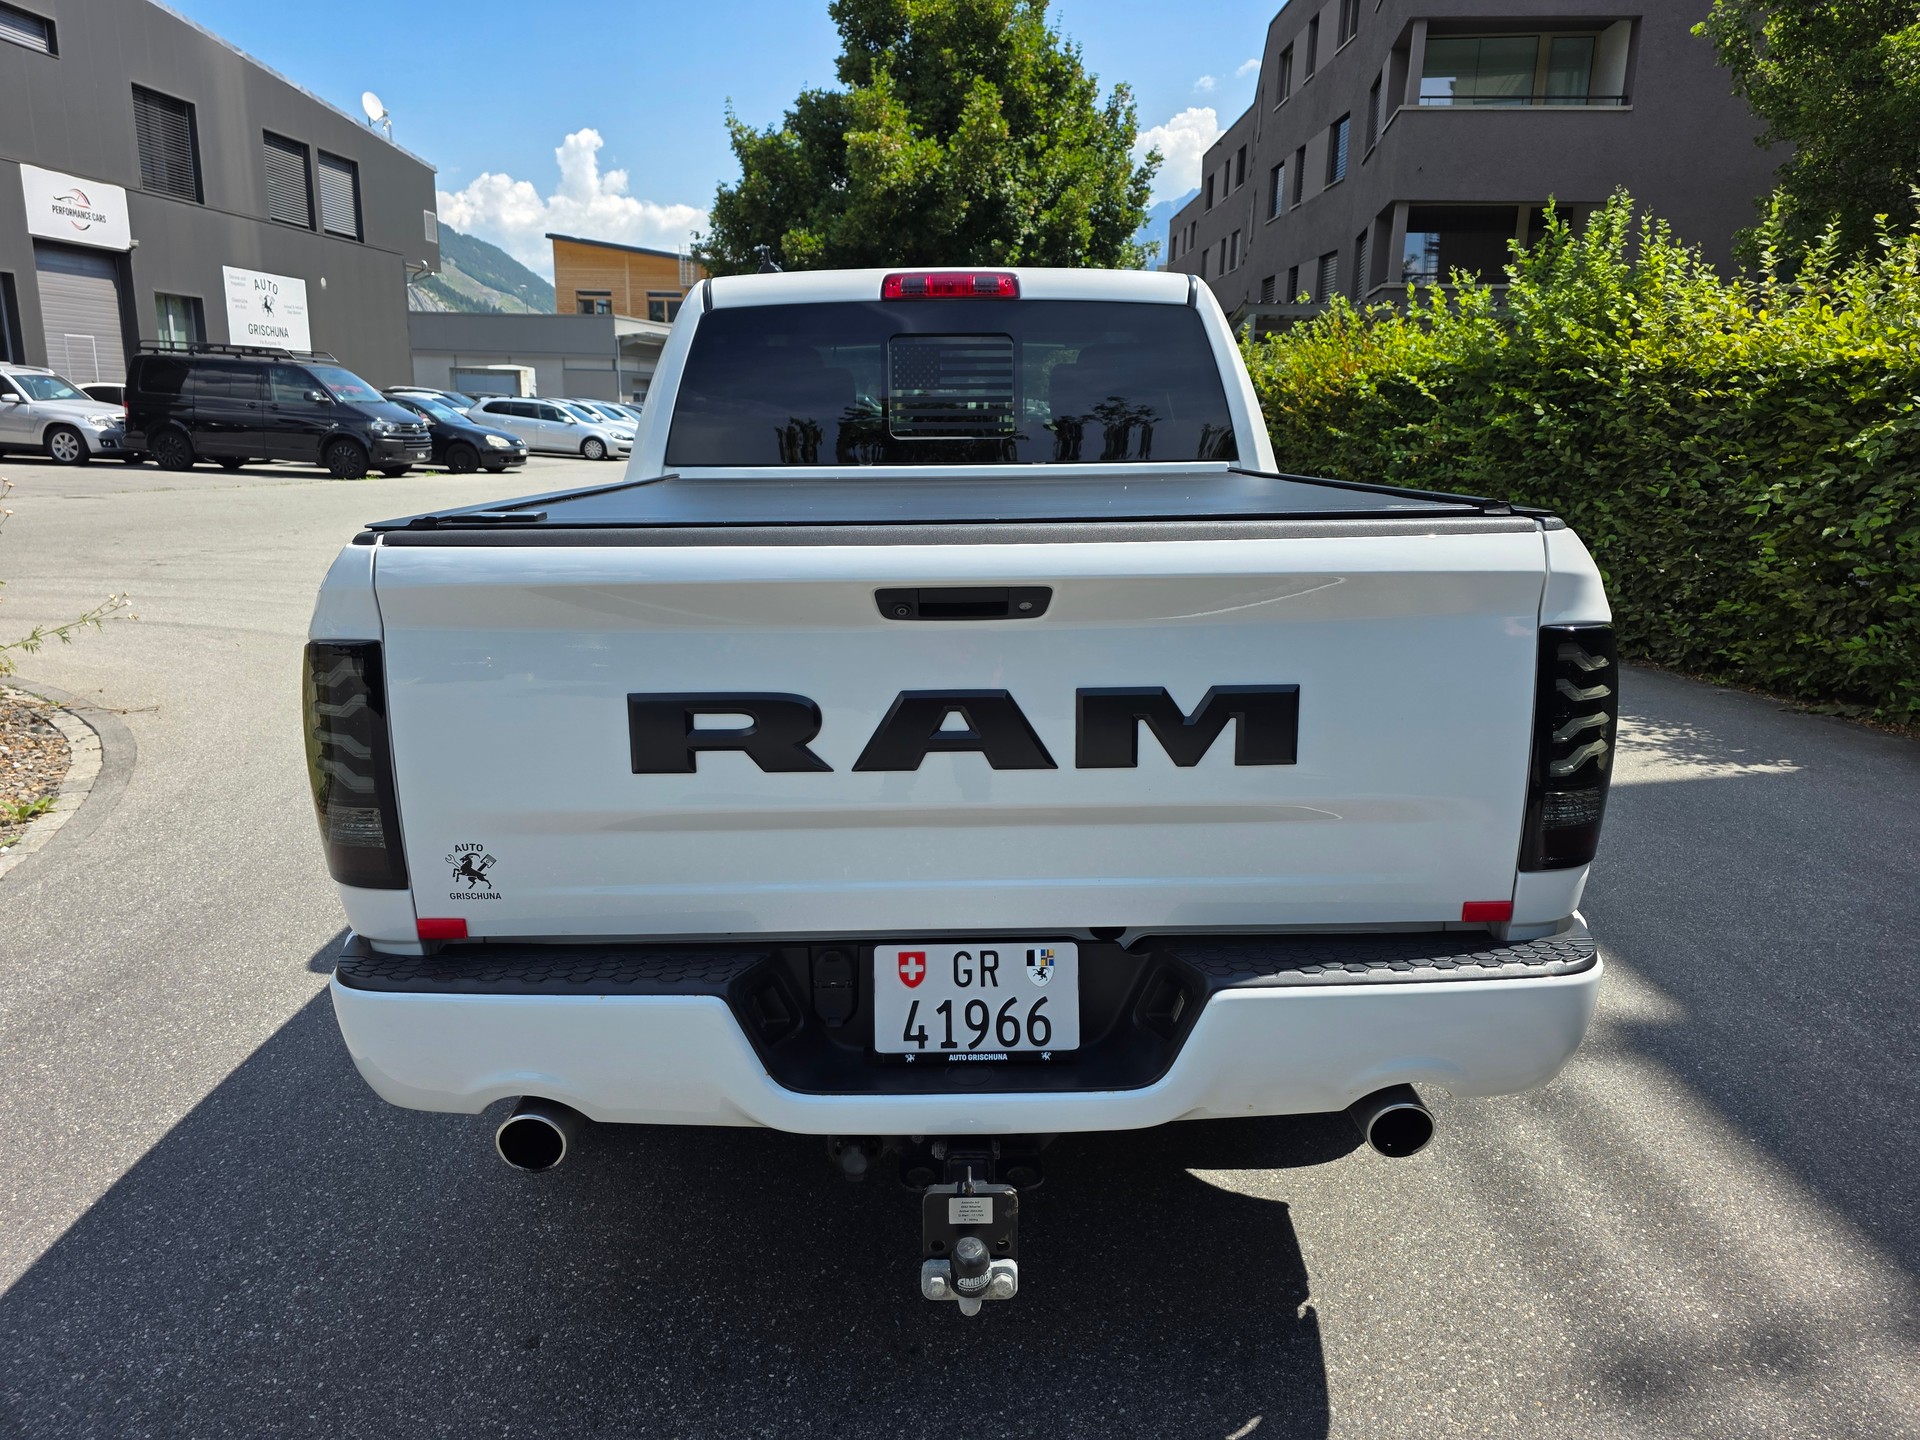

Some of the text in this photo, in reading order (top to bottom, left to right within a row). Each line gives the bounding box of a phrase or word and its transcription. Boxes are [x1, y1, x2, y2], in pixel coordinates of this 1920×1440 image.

[51, 204, 107, 224] PERFORMANCE CARS
[254, 278, 278, 295] AUTO
[247, 322, 290, 339] GRISCHUNA
[627, 684, 1300, 774] RAM
[454, 843, 484, 853] AUTO
[449, 892, 502, 900] GRISCHUNA
[953, 950, 999, 988] GR
[903, 996, 1052, 1050] 41966
[948, 1053, 1008, 1061] AUTO GRISCHUNA
